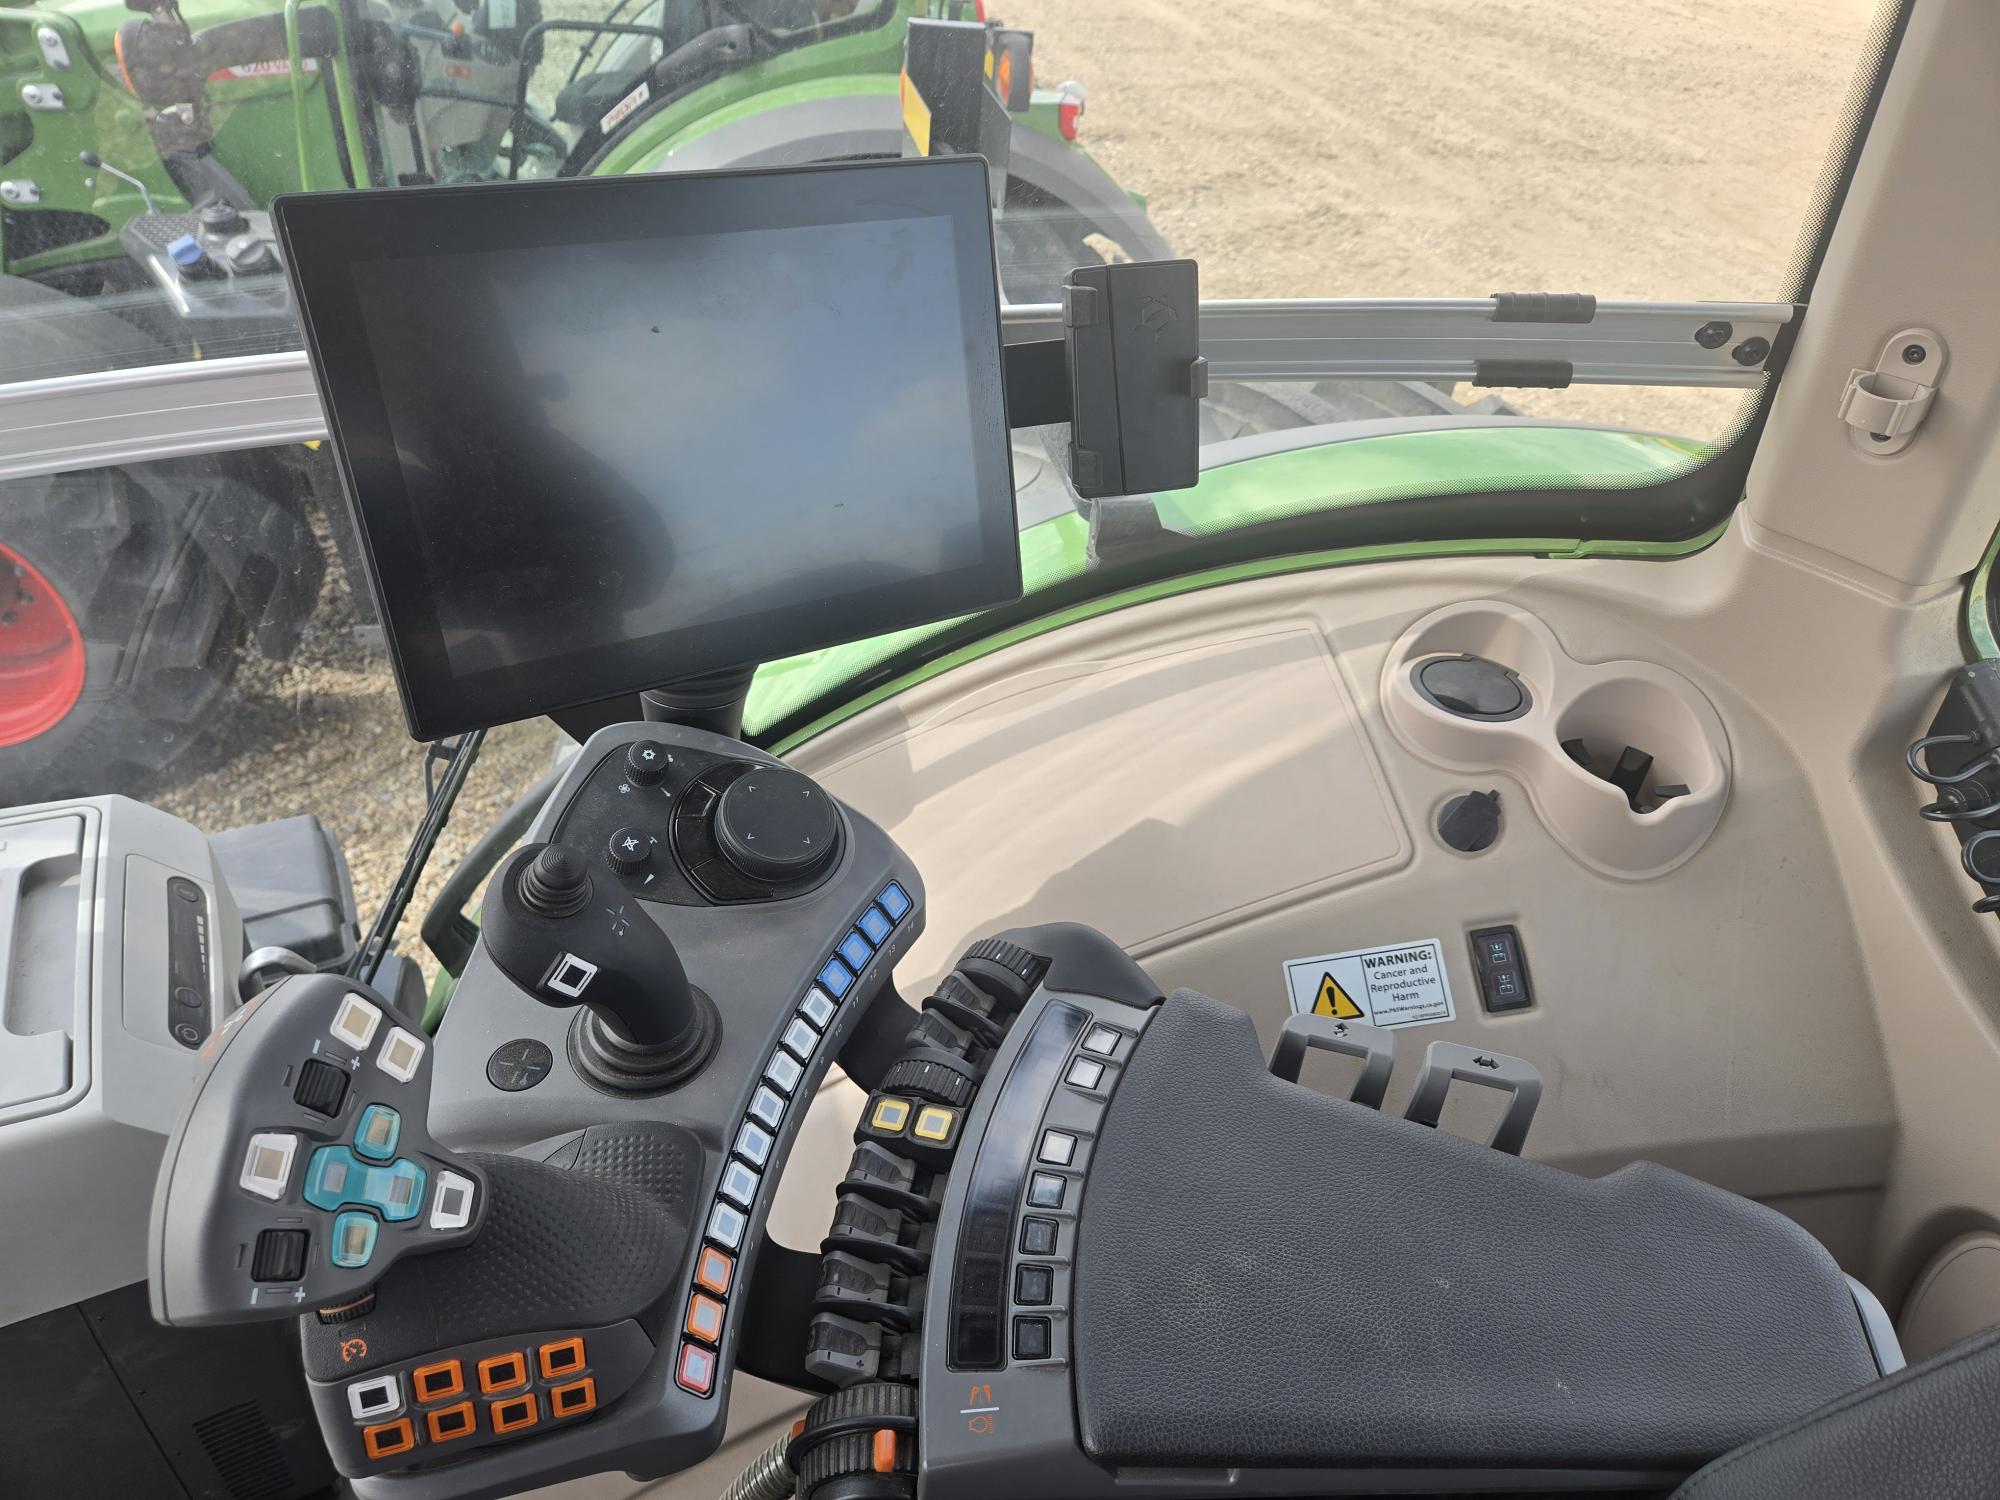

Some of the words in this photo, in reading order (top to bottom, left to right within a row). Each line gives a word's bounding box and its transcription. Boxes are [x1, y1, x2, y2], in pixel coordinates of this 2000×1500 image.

[1364, 950, 1432, 968] WARNING:
[1373, 967, 1407, 980] Cancer
[1409, 964, 1428, 975] and
[1370, 976, 1436, 993] Reproductive
[1392, 991, 1420, 1002] Harm
[1374, 1001, 1444, 1015] www.P65Warnings.ca.gov
